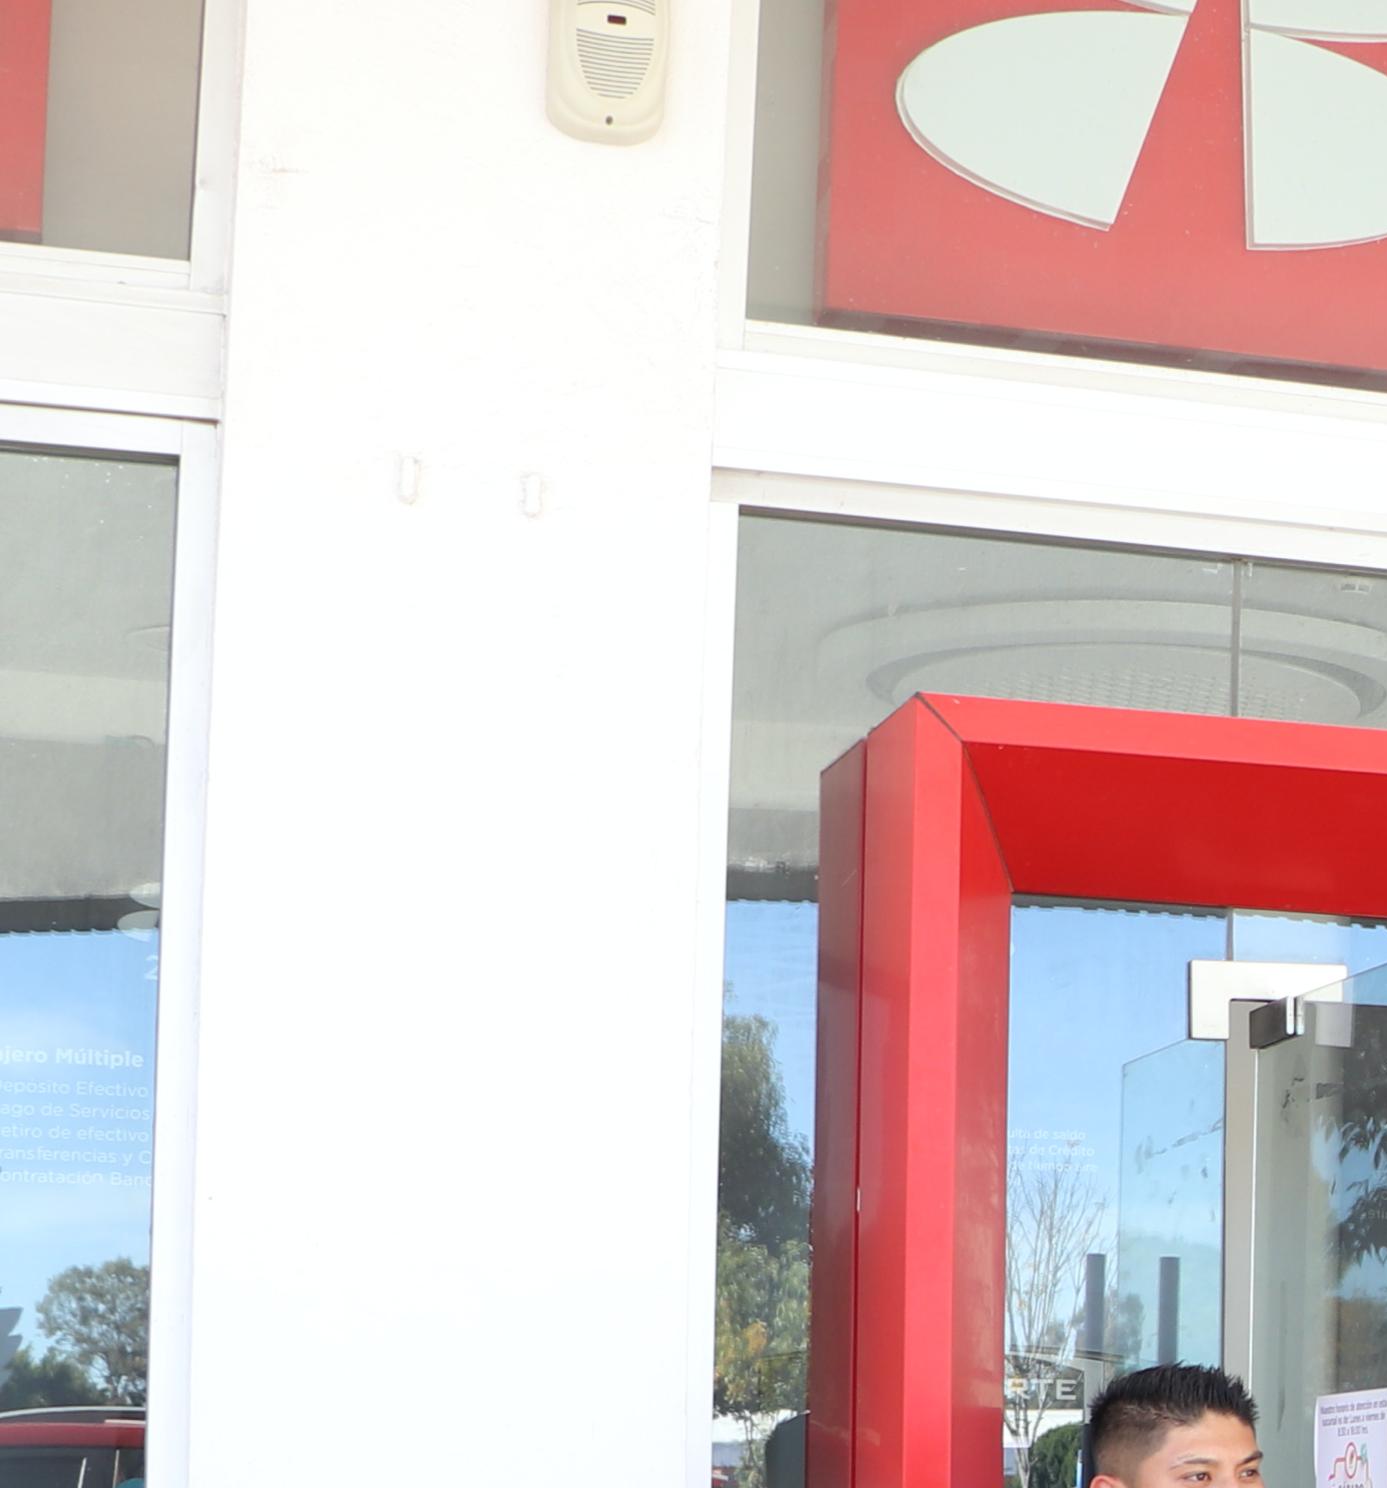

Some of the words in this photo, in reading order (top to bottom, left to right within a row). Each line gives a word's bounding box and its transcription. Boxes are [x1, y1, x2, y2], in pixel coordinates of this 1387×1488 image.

[0, 1045, 48, 1065] jero
[55, 1047, 145, 1069] Múltiple
[0, 1078, 71, 1097] epósito
[75, 1080, 149, 1098] Efectivo
[0, 1102, 35, 1119] ago
[40, 1101, 64, 1117] de
[69, 1103, 151, 1121] Servicios
[0, 1124, 43, 1140] etiro
[48, 1125, 72, 1140] de
[77, 1125, 150, 1143] efectivo
[0, 1167, 103, 1185] ontratación
